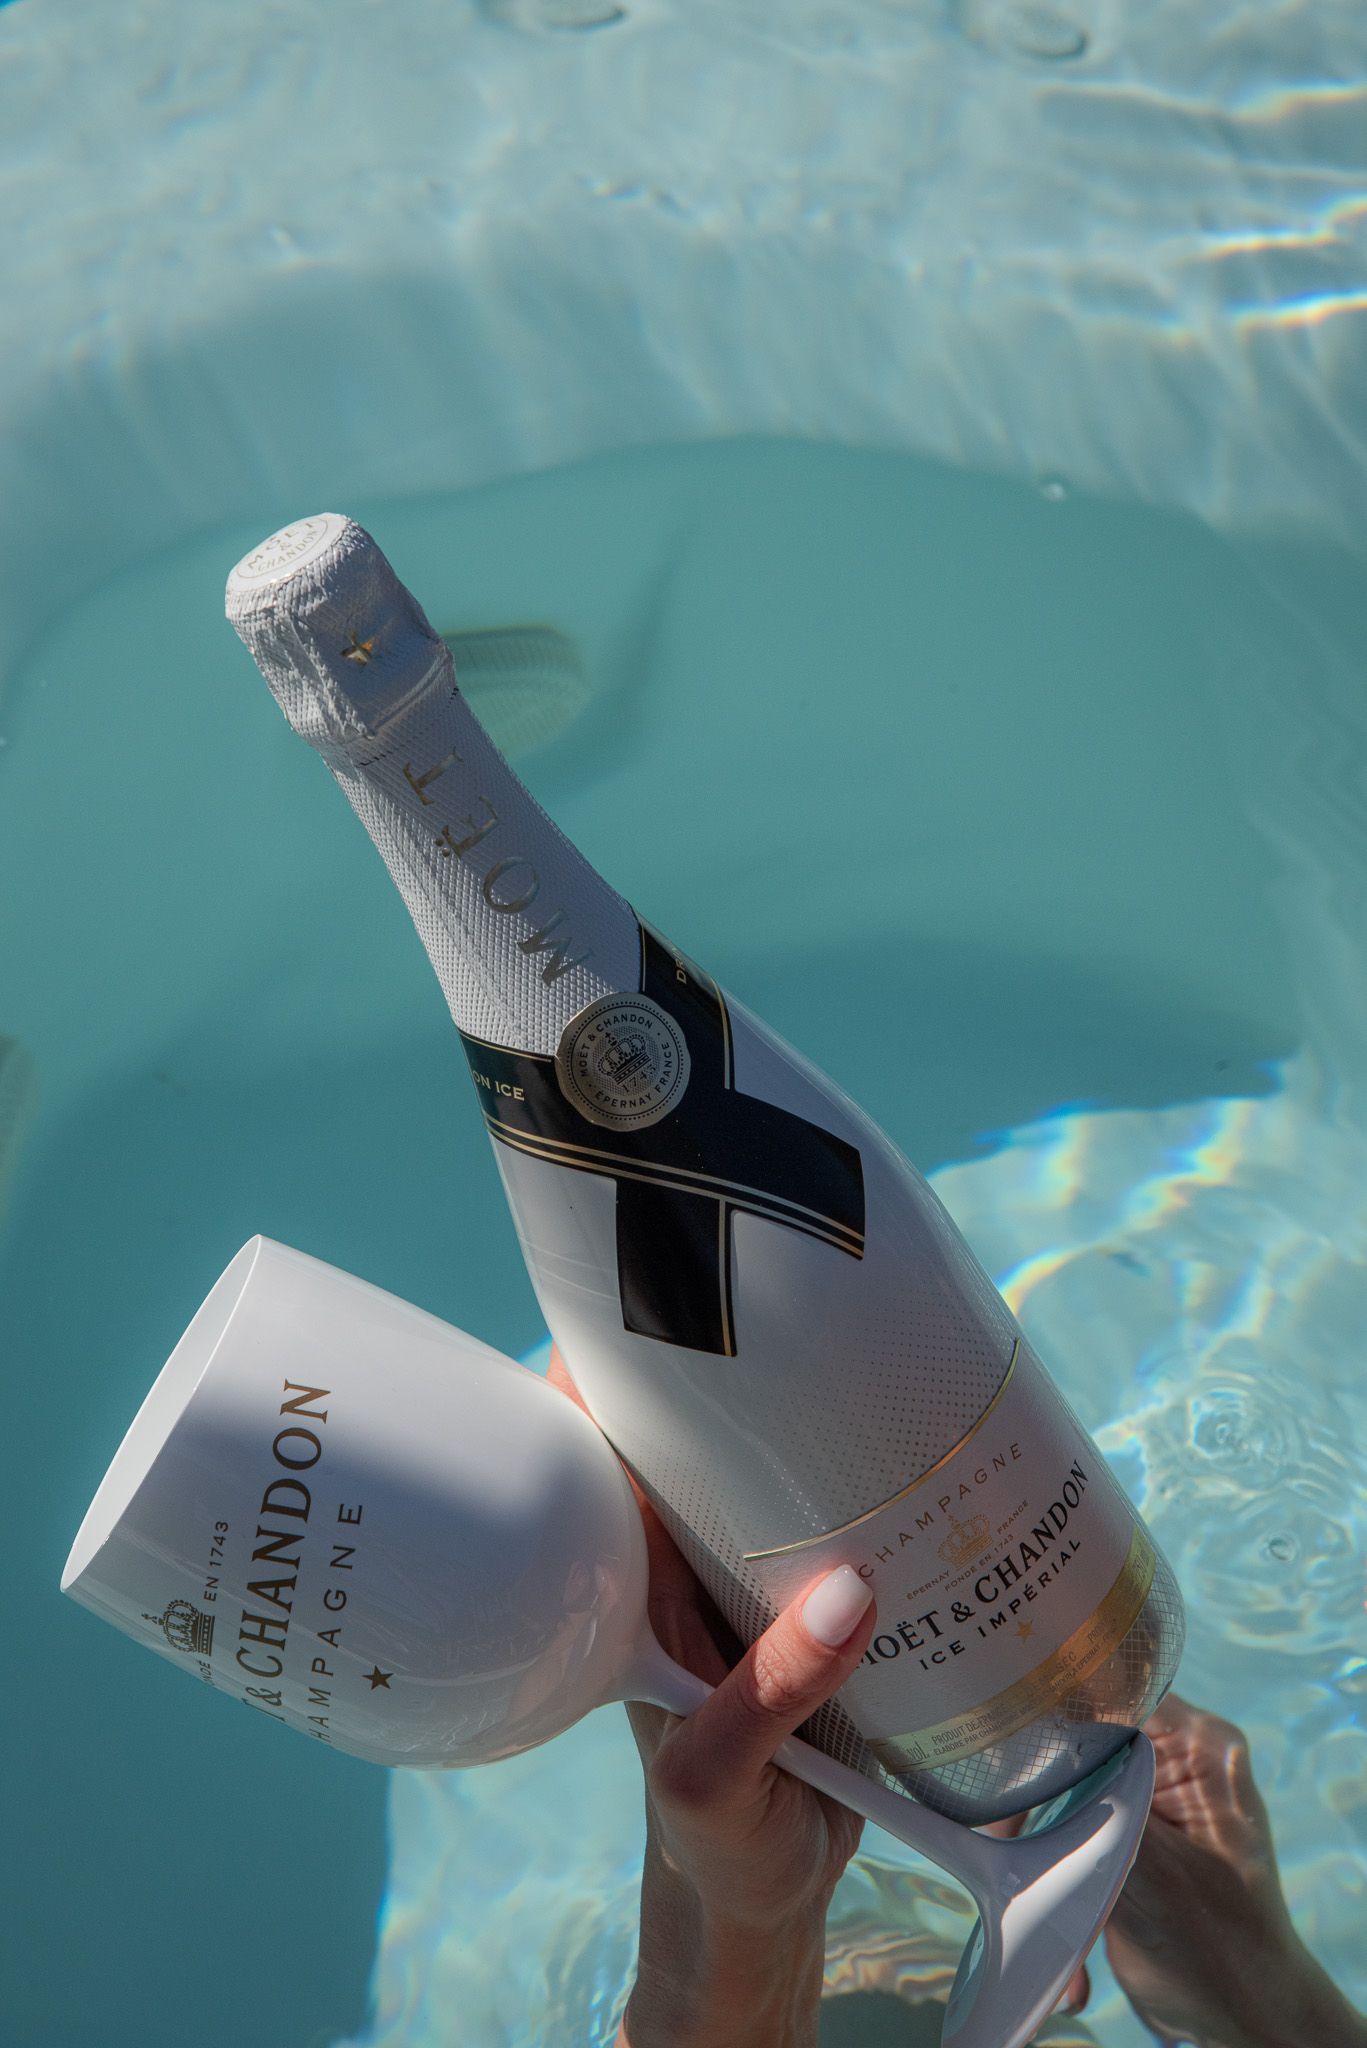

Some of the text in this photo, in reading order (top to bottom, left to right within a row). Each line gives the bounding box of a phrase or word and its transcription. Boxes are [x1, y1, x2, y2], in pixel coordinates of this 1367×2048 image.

[403, 746, 595, 987] MOËT
[587, 1032, 597, 1042] &
[596, 1013, 653, 1032] CHANDON
[495, 1080, 525, 1101] ICE
[654, 1041, 673, 1093] FRANCE
[236, 1378, 331, 1678] CHANDON
[858, 1442, 1022, 1580] CHAMPAGNE
[997, 1500, 1029, 1535] FRANCE
[209, 1520, 229, 1567] 1743
[950, 1601, 976, 1624] &
[974, 1459, 1089, 1605] CHANDON
[979, 1553, 992, 1567] EN
[994, 1533, 1014, 1554] 1743
[203, 1576, 219, 1602] EN
[919, 1640, 966, 1671] ICE
[977, 1539, 1081, 1638] IMPÉRIAL
[307, 1503, 363, 1743] HAMPAGNE
[245, 1686, 282, 1707] &
[931, 1725, 967, 1746] PRODUIT
[965, 1719, 980, 1734] DE
